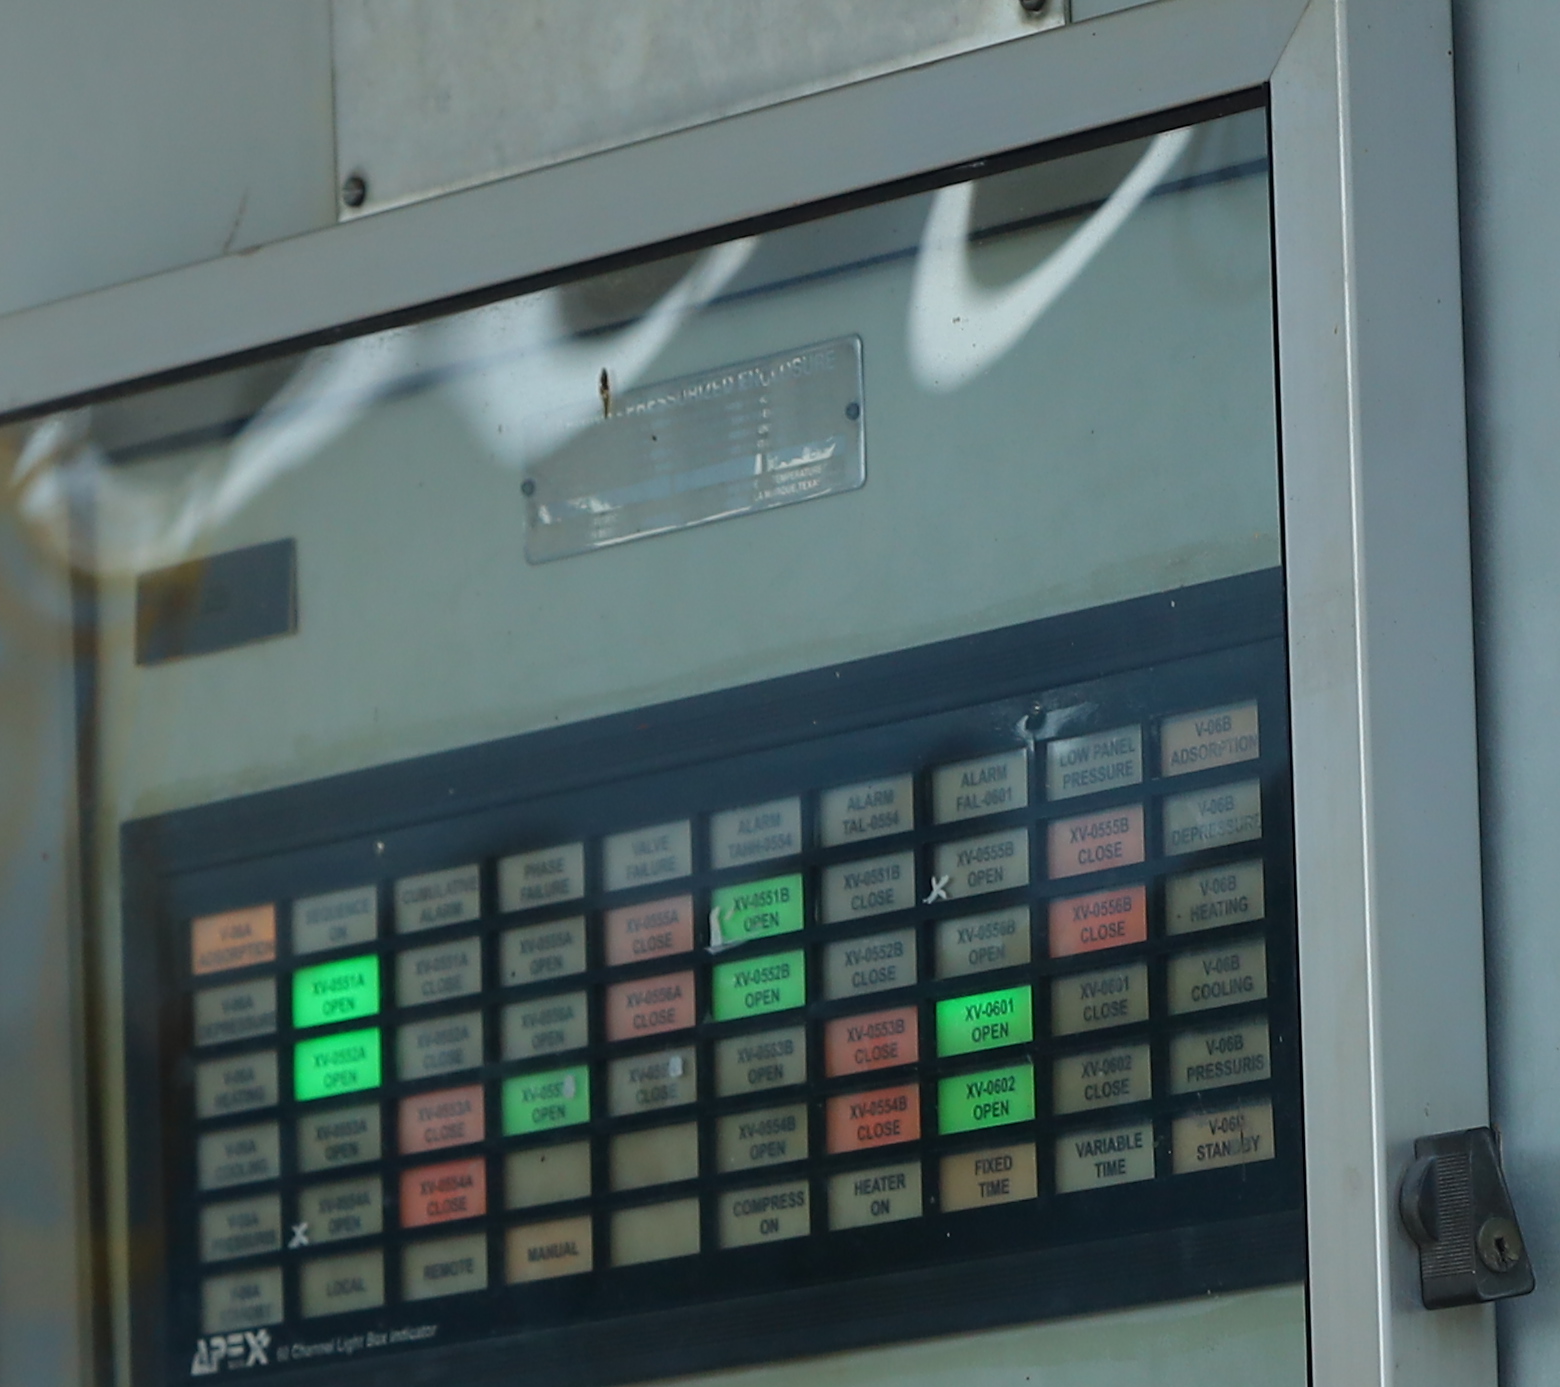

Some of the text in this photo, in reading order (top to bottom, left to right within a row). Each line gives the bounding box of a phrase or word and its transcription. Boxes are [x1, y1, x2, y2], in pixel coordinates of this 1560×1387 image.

[1059, 739, 1136, 767] LOW PANEL
[960, 766, 1008, 788] ALARM
[1063, 760, 1134, 790] PRESSURE
[847, 790, 895, 812] ALARM
[737, 812, 782, 834] ALARM
[1069, 821, 1130, 844] XV-0555B
[1077, 843, 1123, 865] CLOSE
[967, 867, 1003, 887] OPEN
[851, 888, 895, 910] CLOSE
[1190, 896, 1249, 922] HEATING
[743, 912, 779, 932] OPEN
[1072, 900, 1132, 922] XV-0556B
[632, 932, 672, 955] CLOSE
[1080, 922, 1127, 944] CLOSE
[845, 941, 904, 967] XV-0552B
[968, 944, 1006, 965] OPEN
[734, 963, 790, 988] XV-0552B
[851, 966, 897, 988] CLOSE
[744, 989, 780, 1009] OPEN
[1191, 975, 1255, 1002] COOLING
[323, 996, 355, 1015] OPEN
[965, 999, 1015, 1021] XV-0601
[1083, 999, 1128, 1022] CLOSE
[634, 1008, 675, 1030] CLOSE
[847, 1019, 905, 1043] XV-0553B
[971, 1022, 1010, 1043] OPEN
[854, 1042, 898, 1064] CLOSE
[324, 1068, 358, 1088] OPEN
[747, 1064, 783, 1084] OPEN
[1187, 1055, 1266, 1083] PRESSURIS
[966, 1076, 1016, 1099] XV-0602
[1084, 1079, 1130, 1101] CLOSE
[850, 1096, 908, 1120] XV-0554B
[973, 1100, 1010, 1121] OPEN
[424, 1122, 465, 1144] CLOSE
[857, 1120, 901, 1141] CLOSE
[749, 1141, 786, 1160] OPEN
[1076, 1131, 1143, 1158] VARIABLE
[975, 1155, 1013, 1176] FIXED
[1095, 1158, 1127, 1179] TIME
[854, 1173, 906, 1197] HEATER
[979, 1176, 1010, 1198] TIME
[427, 1196, 467, 1216] CLOSE
[732, 1190, 805, 1217] COMPRESS
[870, 1198, 890, 1216] ON
[759, 1217, 779, 1235] ON
[527, 1240, 579, 1262] MANUAL
